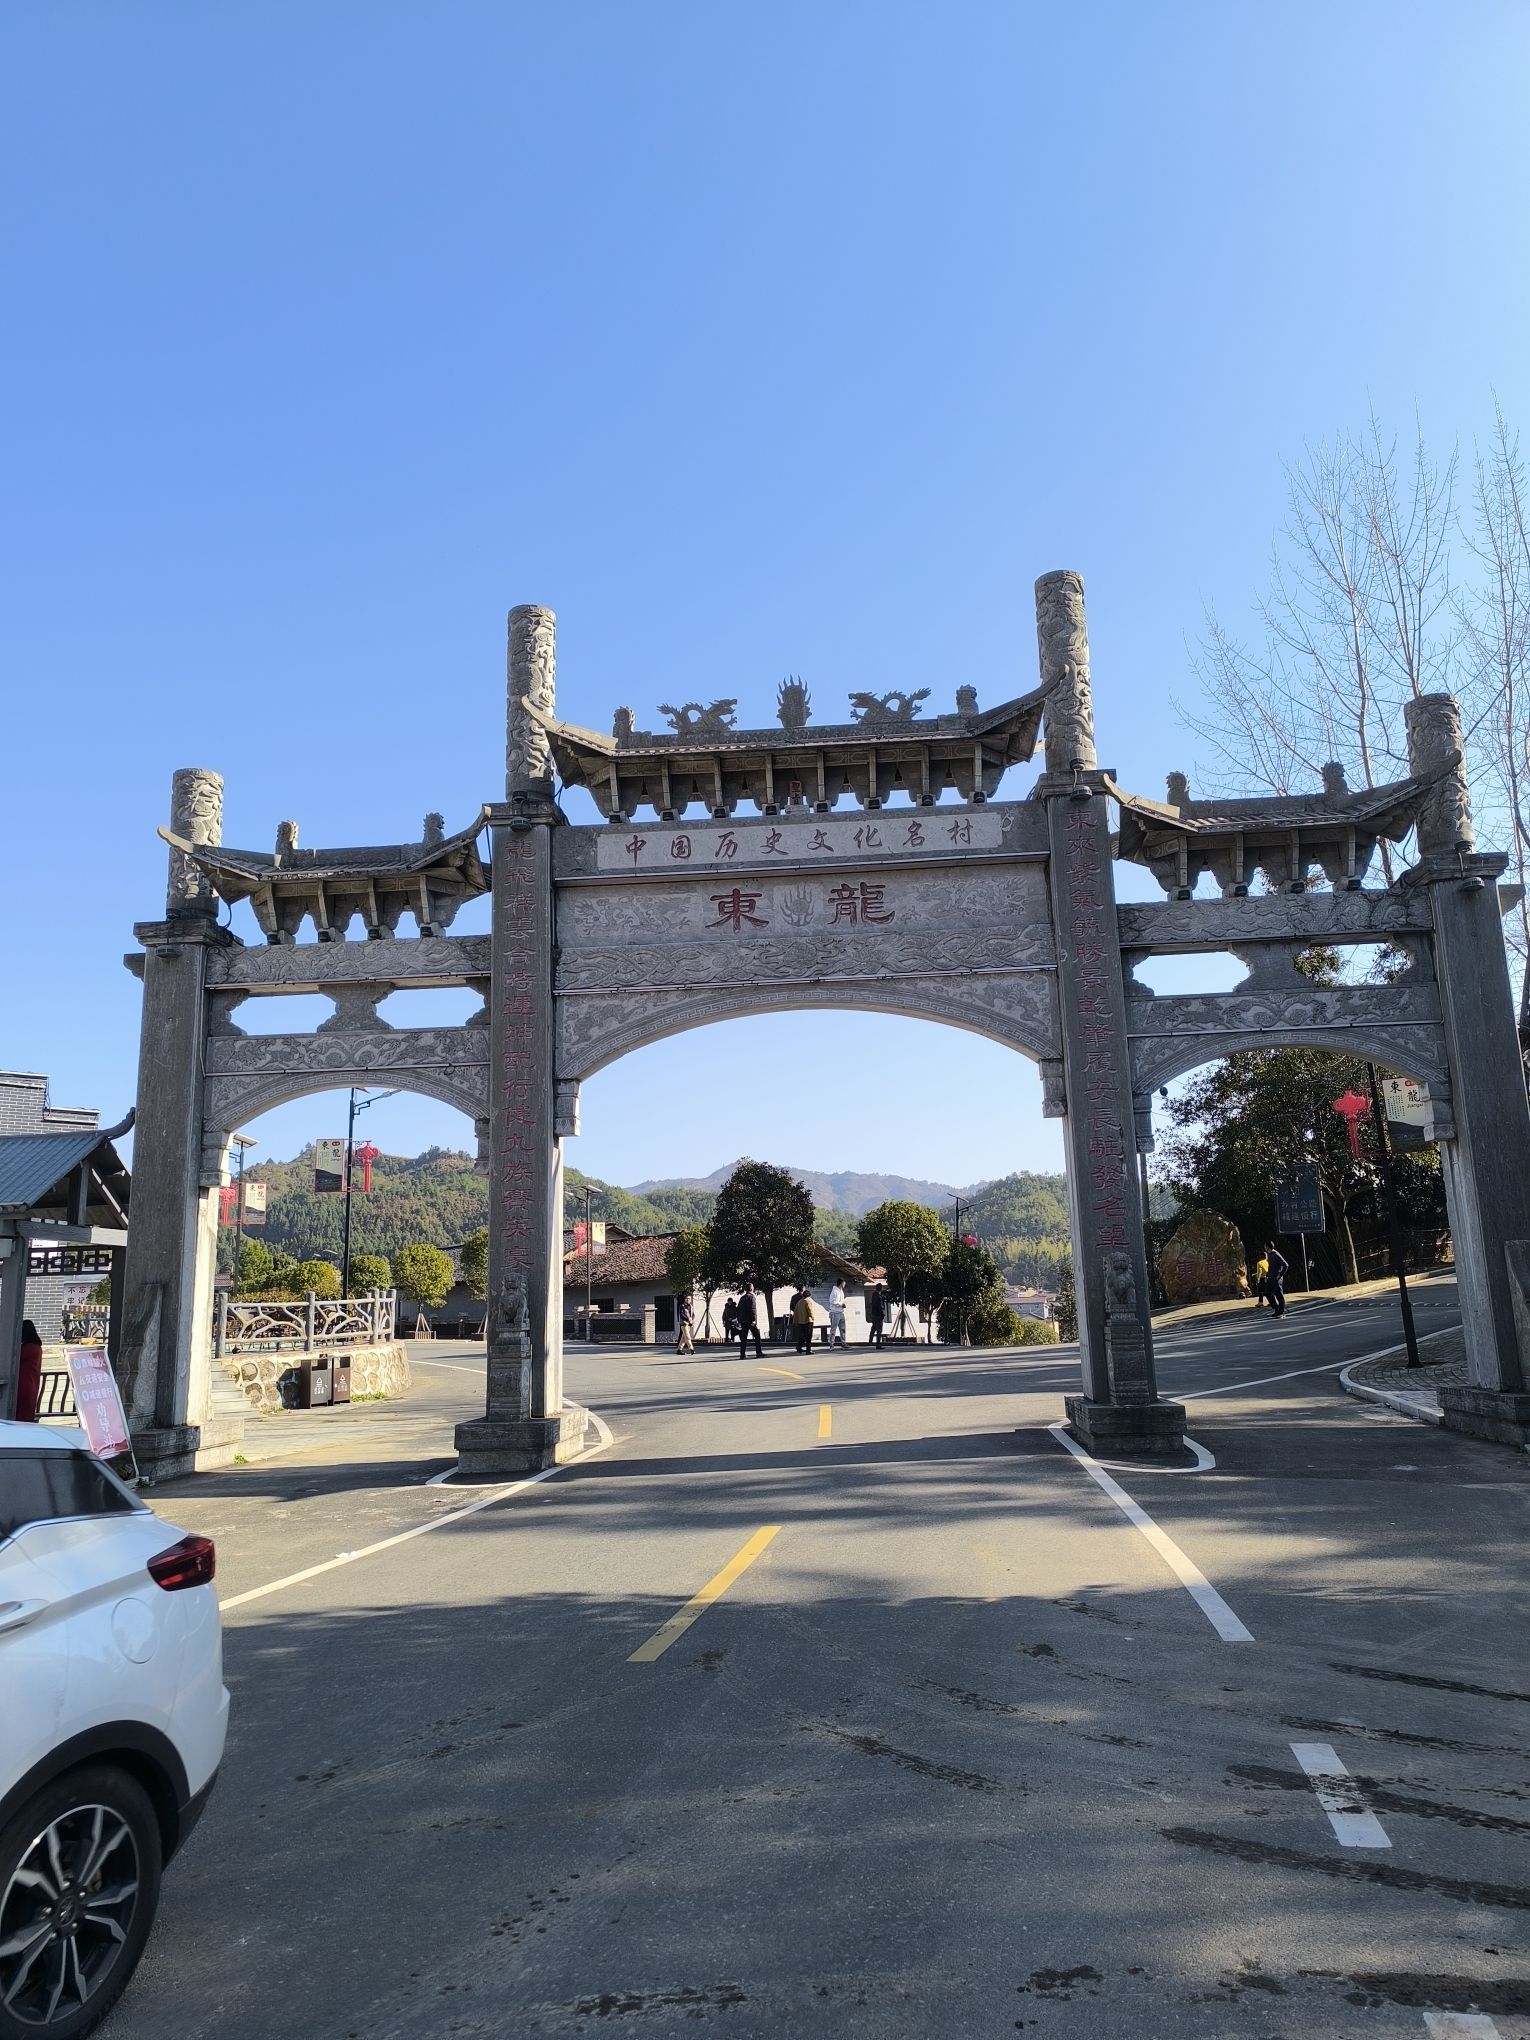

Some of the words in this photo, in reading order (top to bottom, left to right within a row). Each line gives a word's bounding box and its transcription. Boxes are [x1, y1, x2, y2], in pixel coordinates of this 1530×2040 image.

[625, 818, 975, 867] 中国历史文化名村
[705, 882, 897, 932] 東龍
